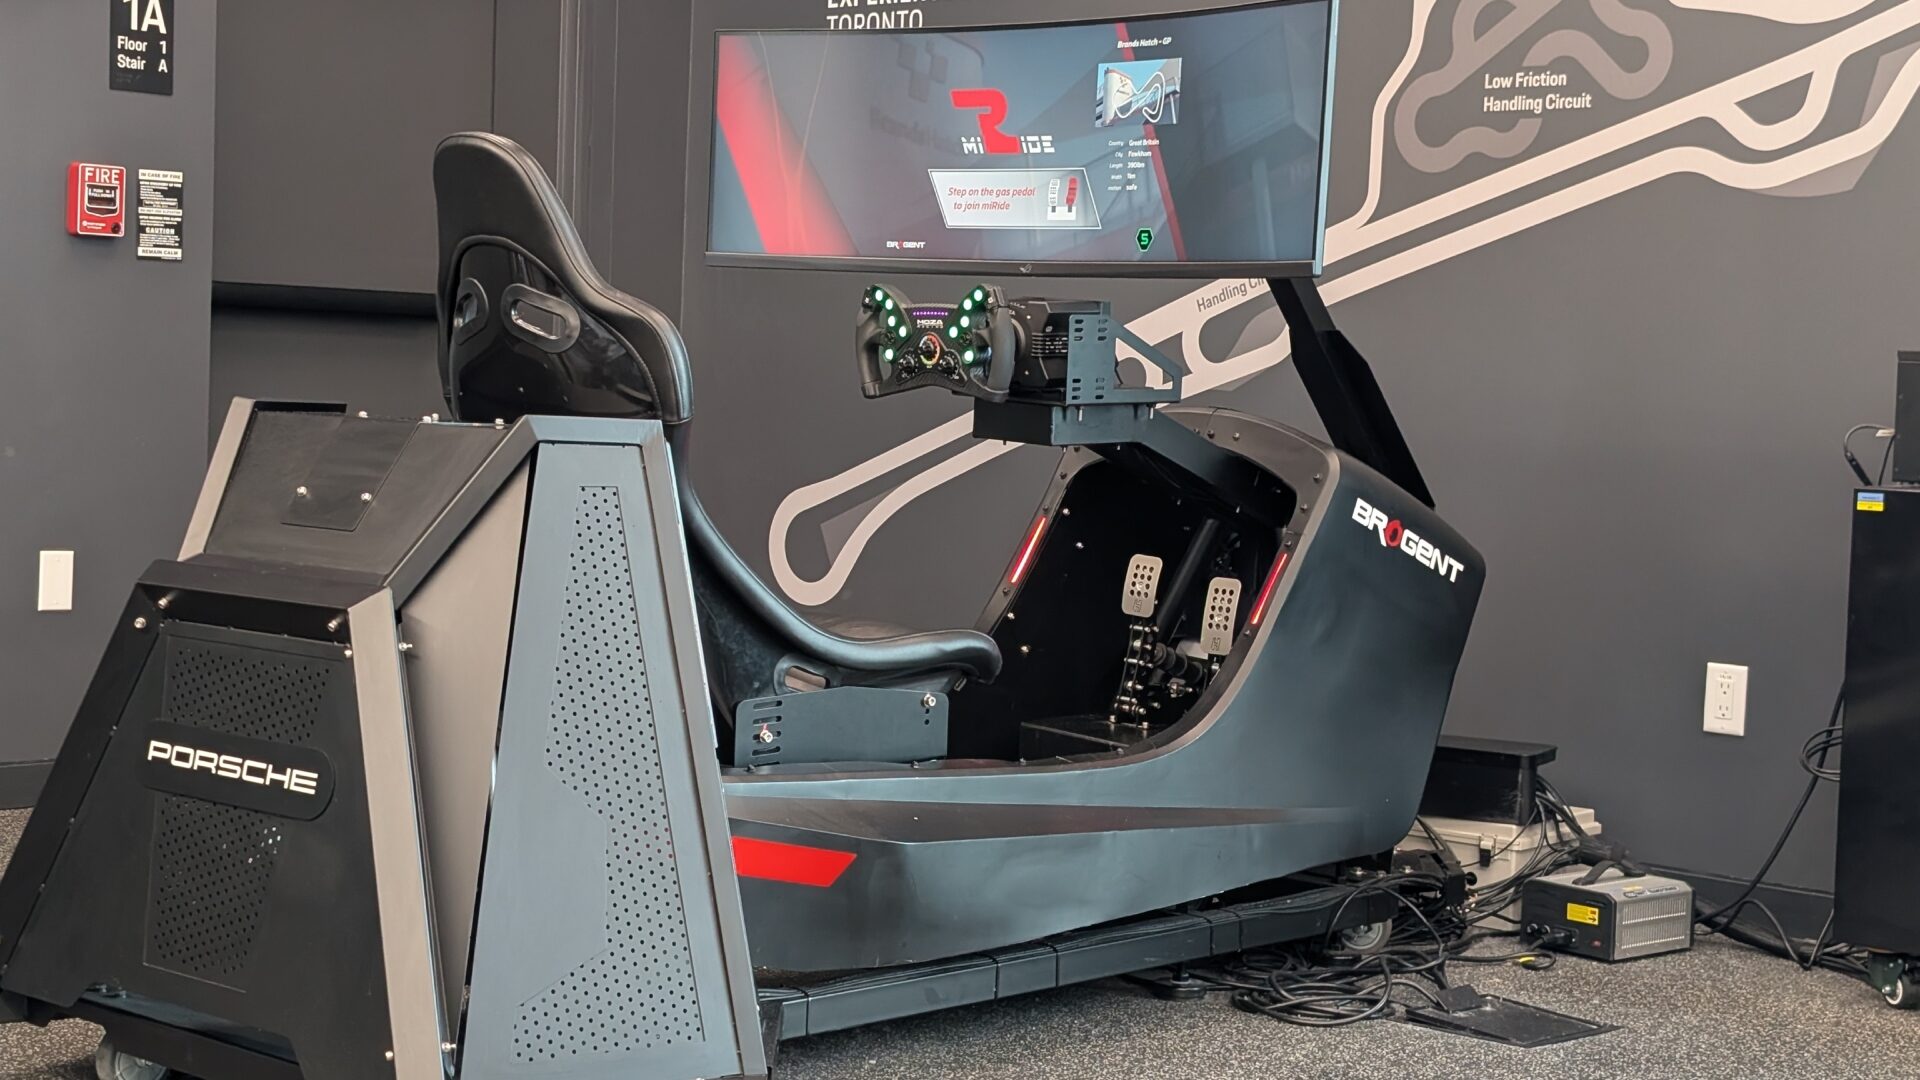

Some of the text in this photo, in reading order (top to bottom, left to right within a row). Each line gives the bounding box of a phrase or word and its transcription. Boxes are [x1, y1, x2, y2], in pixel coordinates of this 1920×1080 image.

[123, 0, 167, 34] 1A
[117, 35, 167, 54] Floor 1
[1117, 39, 1139, 48] Brands
[1140, 38, 1158, 47] Hatch
[1162, 37, 1172, 45] GP
[117, 54, 168, 73] Stair A
[1484, 71, 1567, 89] Low Friction
[1483, 92, 1592, 114] Handling Circuit
[1128, 139, 1142, 147] Great
[1143, 138, 1160, 146] Britain
[85, 167, 120, 185] FIRE
[948, 187, 967, 198] Step
[980, 186, 994, 196] the
[995, 189, 1011, 198] gas
[1011, 186, 1036, 198] pedal
[953, 201, 1011, 212] to join miRide
[145, 227, 175, 235] CAUTION
[886, 240, 926, 250] BROGENT
[1197, 282, 1248, 313] Handling
[1351, 497, 1464, 583] BROGENT
[147, 740, 319, 795] PORSCHE
